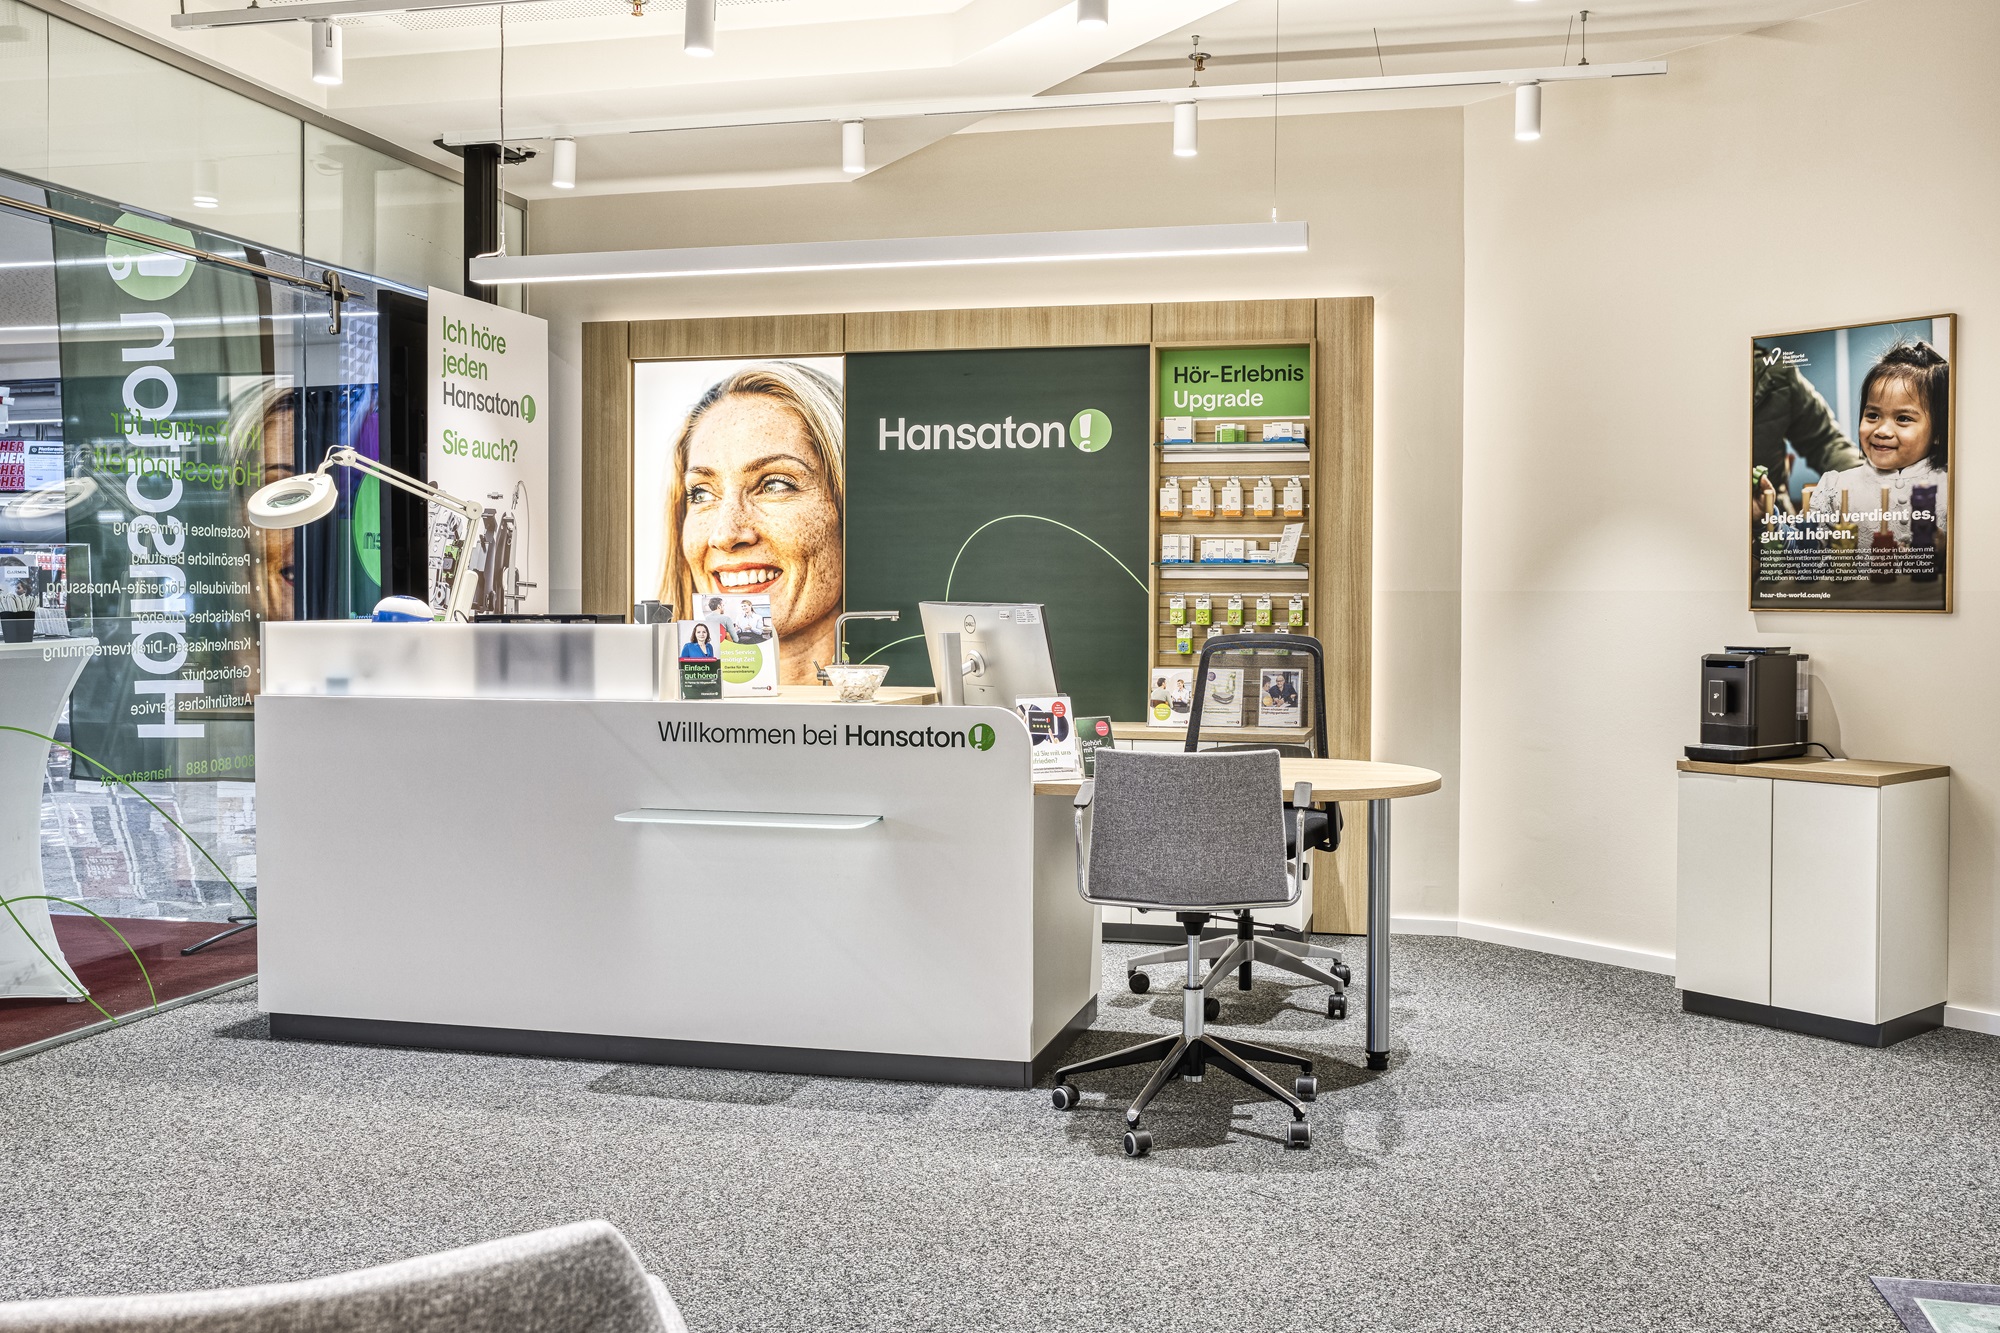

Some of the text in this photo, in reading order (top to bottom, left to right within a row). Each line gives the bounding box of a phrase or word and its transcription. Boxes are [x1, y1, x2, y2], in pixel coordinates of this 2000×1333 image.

[442, 316, 506, 354] Ich höre
[441, 348, 488, 380] jeden
[1174, 364, 1304, 384] Hör-Erlebnis
[443, 381, 519, 418] Hansaton
[1174, 389, 1264, 412] Upgrade
[442, 429, 518, 463] Sie auch?
[879, 415, 1066, 450] Hansaton
[1761, 509, 1935, 524] Jedes Kind verdient es,
[1760, 528, 1855, 543] gut zu hören.
[658, 721, 965, 748] Willkommen bei Hansaton
[1082, 739, 1102, 747] Gehört
